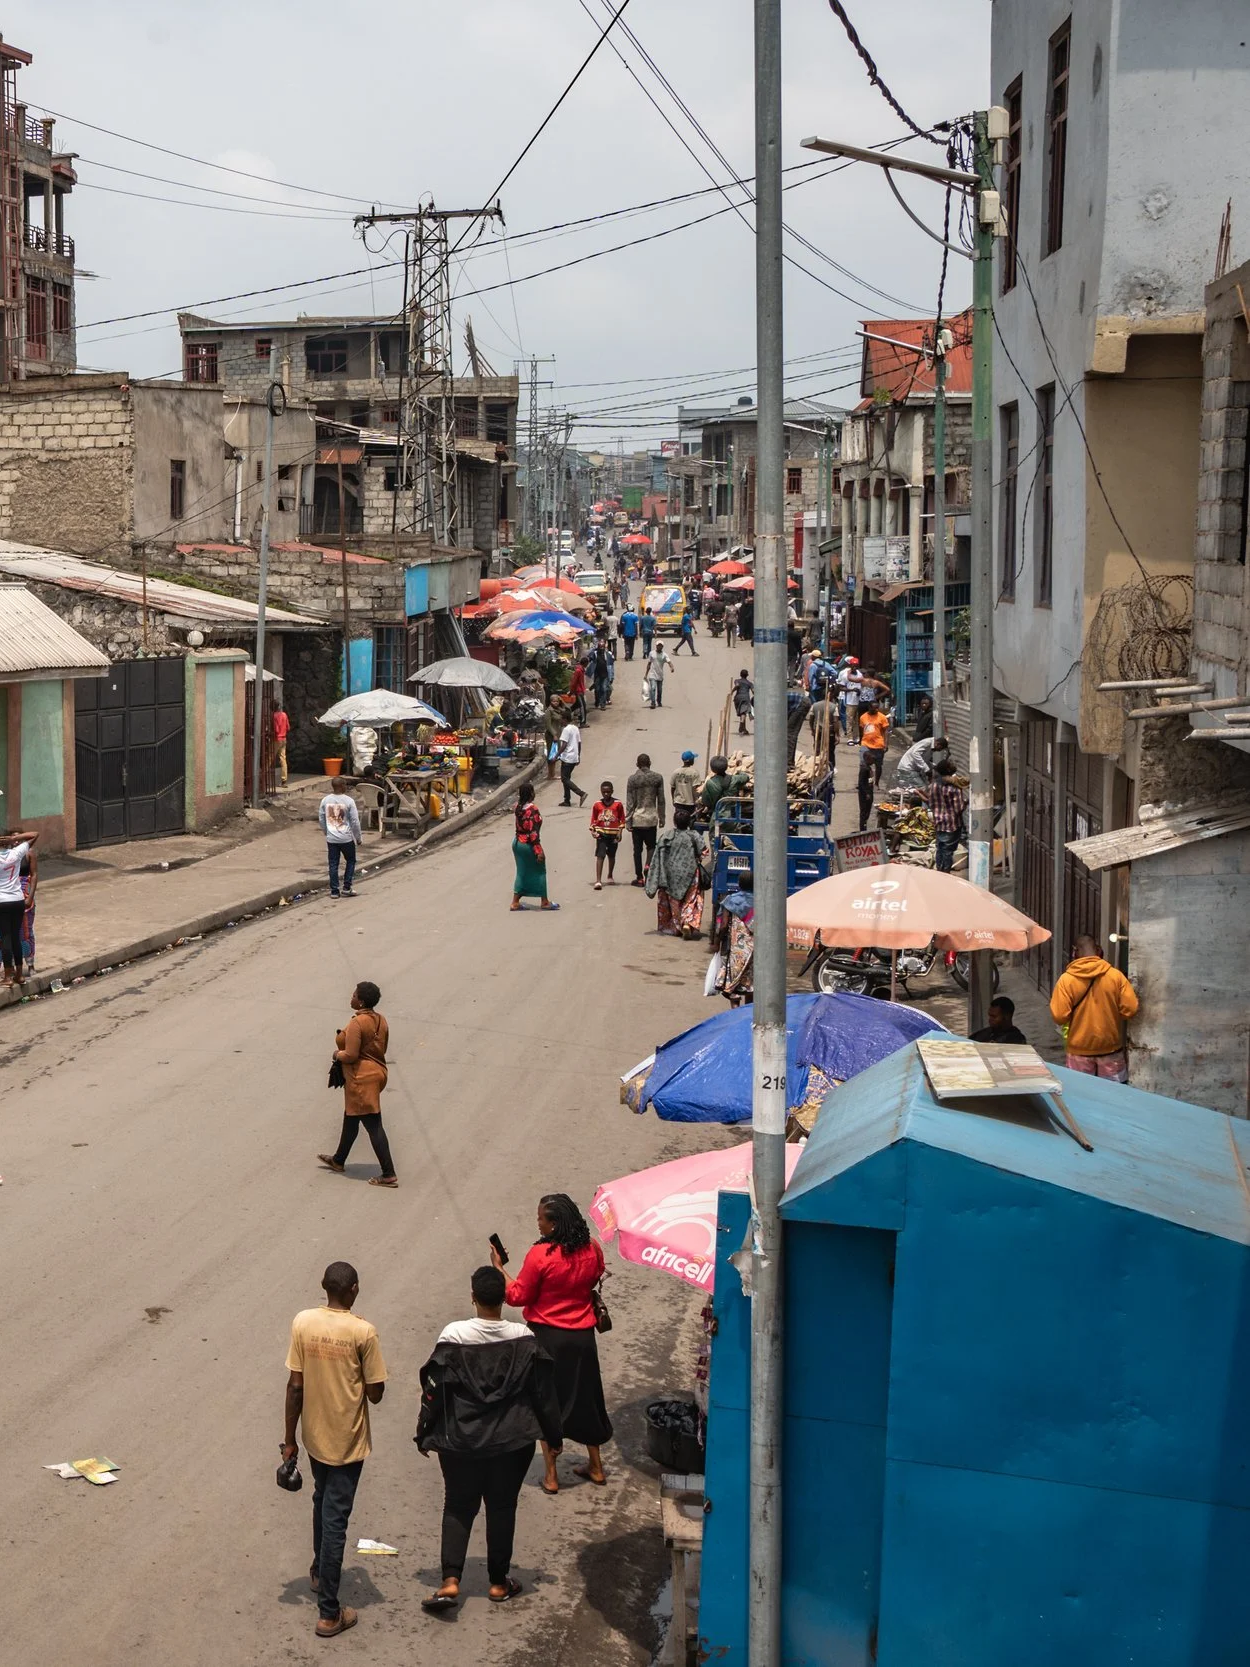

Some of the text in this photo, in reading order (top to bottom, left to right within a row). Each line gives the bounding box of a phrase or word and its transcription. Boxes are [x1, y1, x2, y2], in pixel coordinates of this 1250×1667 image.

[836, 831, 880, 850] EDITION
[845, 844, 882, 859] ROYAL
[4, 865, 15, 880] 7
[851, 897, 908, 912] airtel
[857, 912, 899, 921] money
[762, 1075, 786, 1090] 219
[641, 1246, 714, 1285] africell
